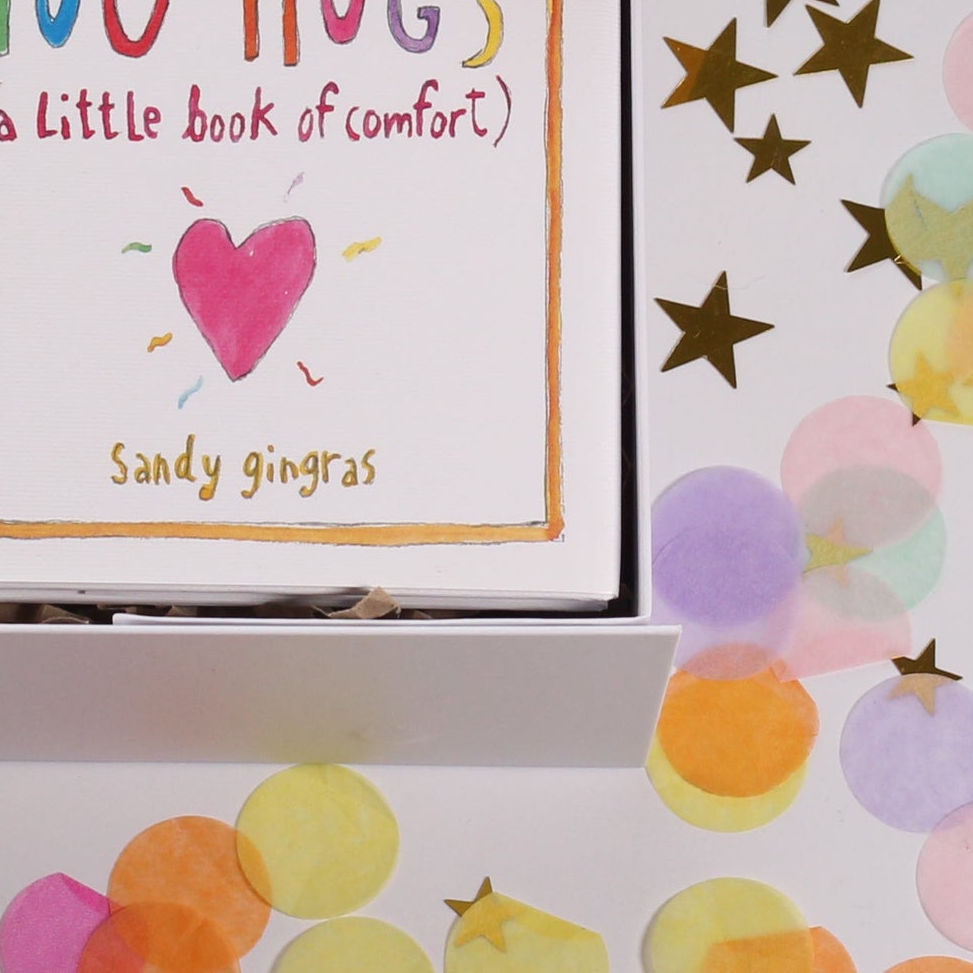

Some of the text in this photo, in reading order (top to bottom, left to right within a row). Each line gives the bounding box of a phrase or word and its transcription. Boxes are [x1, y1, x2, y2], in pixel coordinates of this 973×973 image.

[182, 84, 279, 142] book
[298, 82, 339, 142] of
[345, 75, 513, 148] comfort)
[240, 445, 376, 499] gingras
